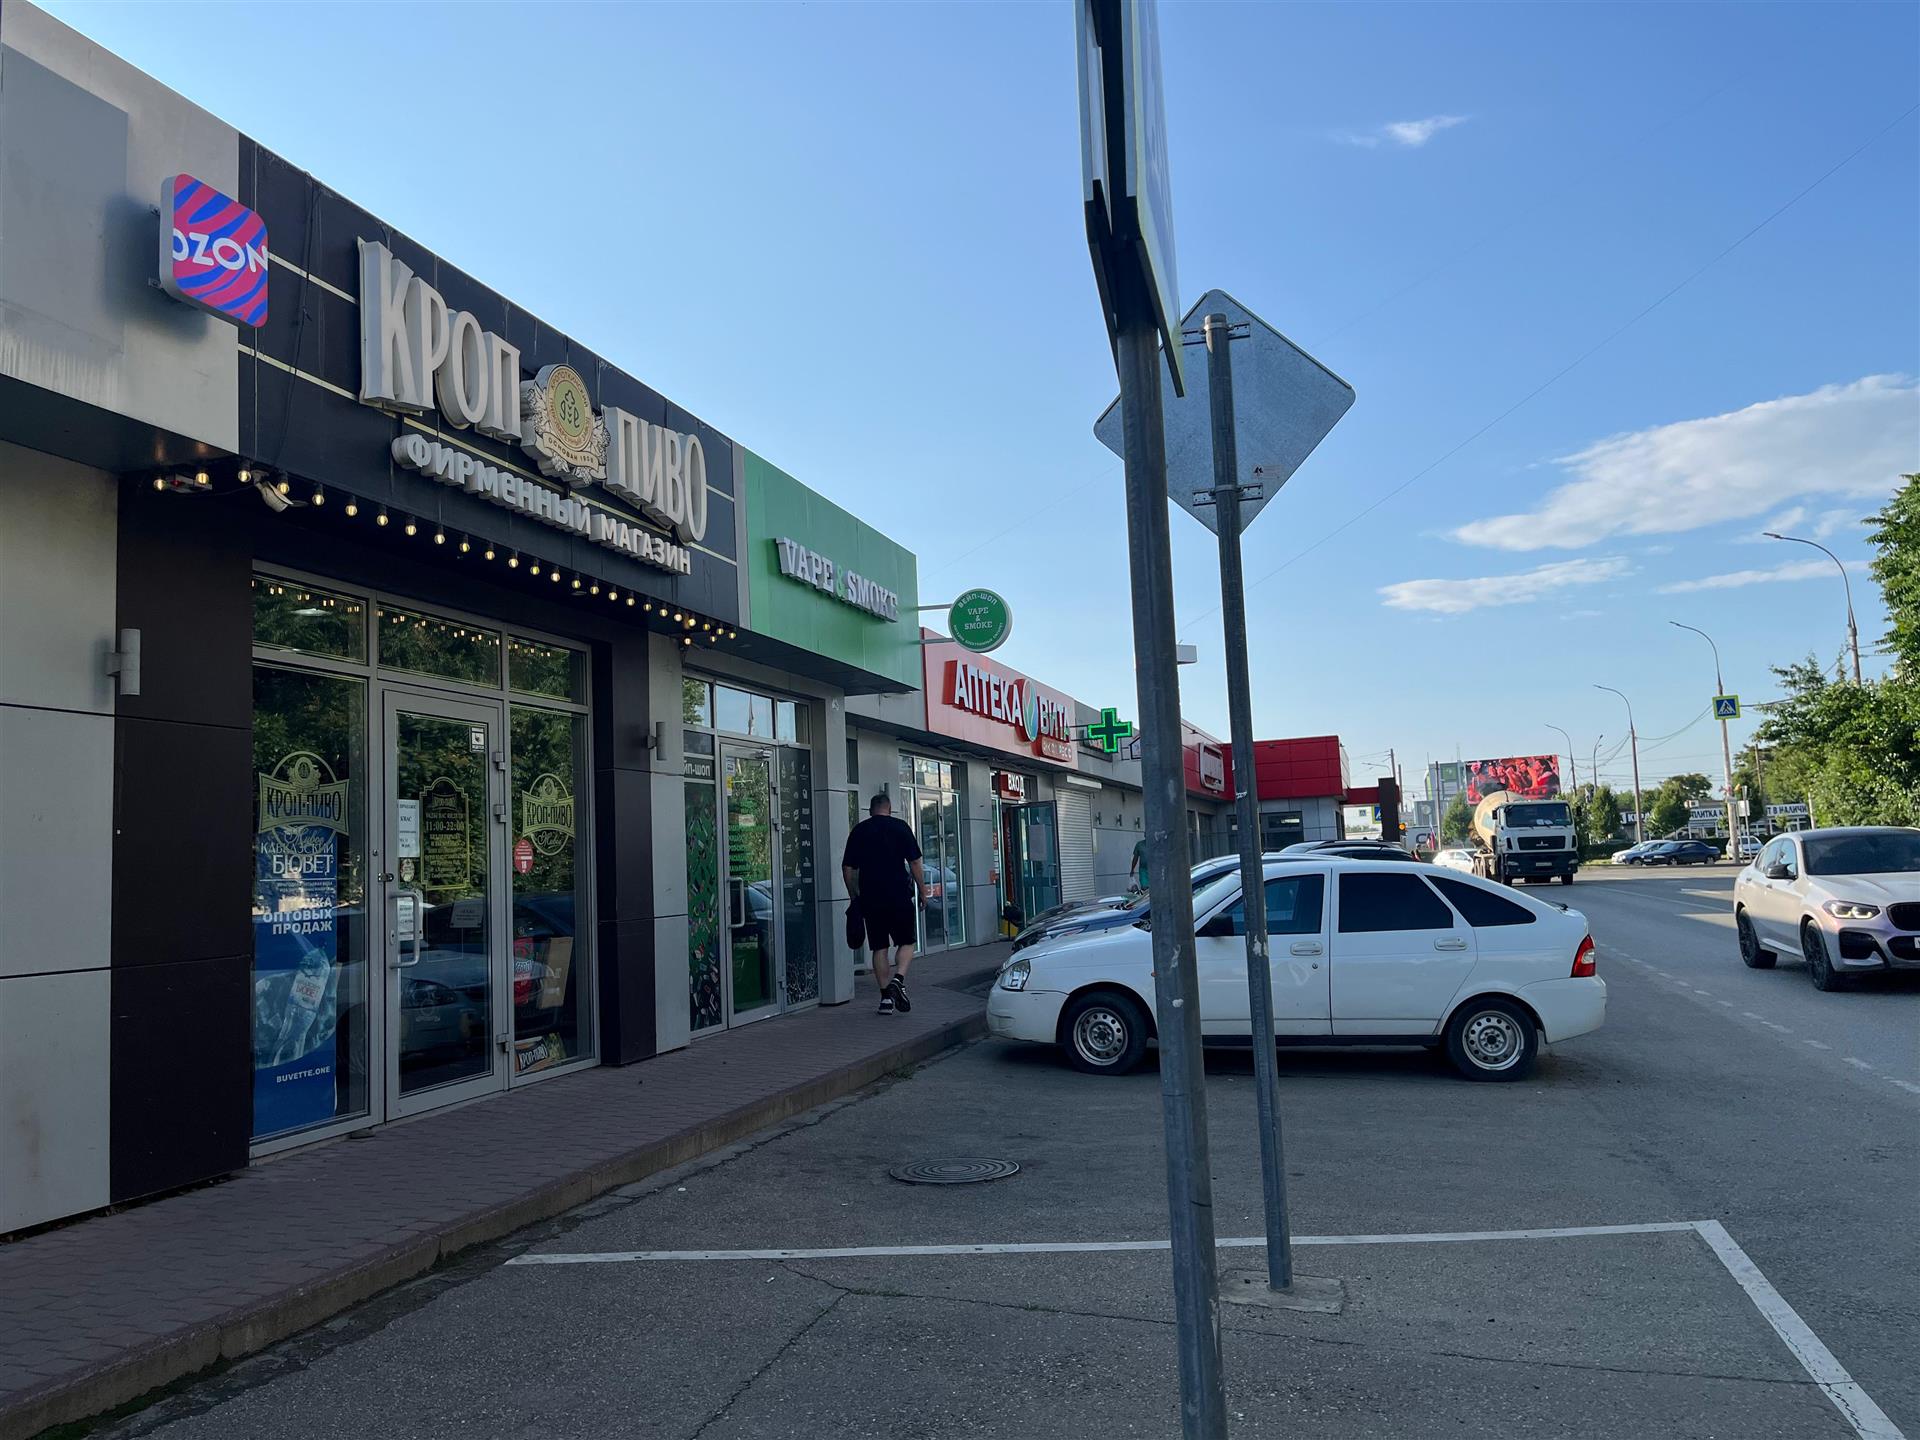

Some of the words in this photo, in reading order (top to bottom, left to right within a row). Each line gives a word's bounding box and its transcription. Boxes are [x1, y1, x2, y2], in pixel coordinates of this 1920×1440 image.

[172, 228, 268, 272] OZON
[358, 236, 521, 441] КРОП
[602, 404, 707, 543] ПИВО
[594, 513, 691, 576] МАГАЗИН
[776, 536, 834, 594] VAPE
[967, 606, 989, 615] VAPE
[964, 621, 993, 630] SMOKE
[954, 659, 1024, 727] АПТЕКА
[1039, 695, 1070, 741] ВИТА
[1007, 773, 1025, 797] ВХОД
[272, 854, 334, 875] БЮВЕТ
[262, 908, 333, 924] ОПТОВЫХ
[272, 920, 333, 936] ПРОДАЖ
[276, 1066, 331, 1083] BUVETTE.ONE
